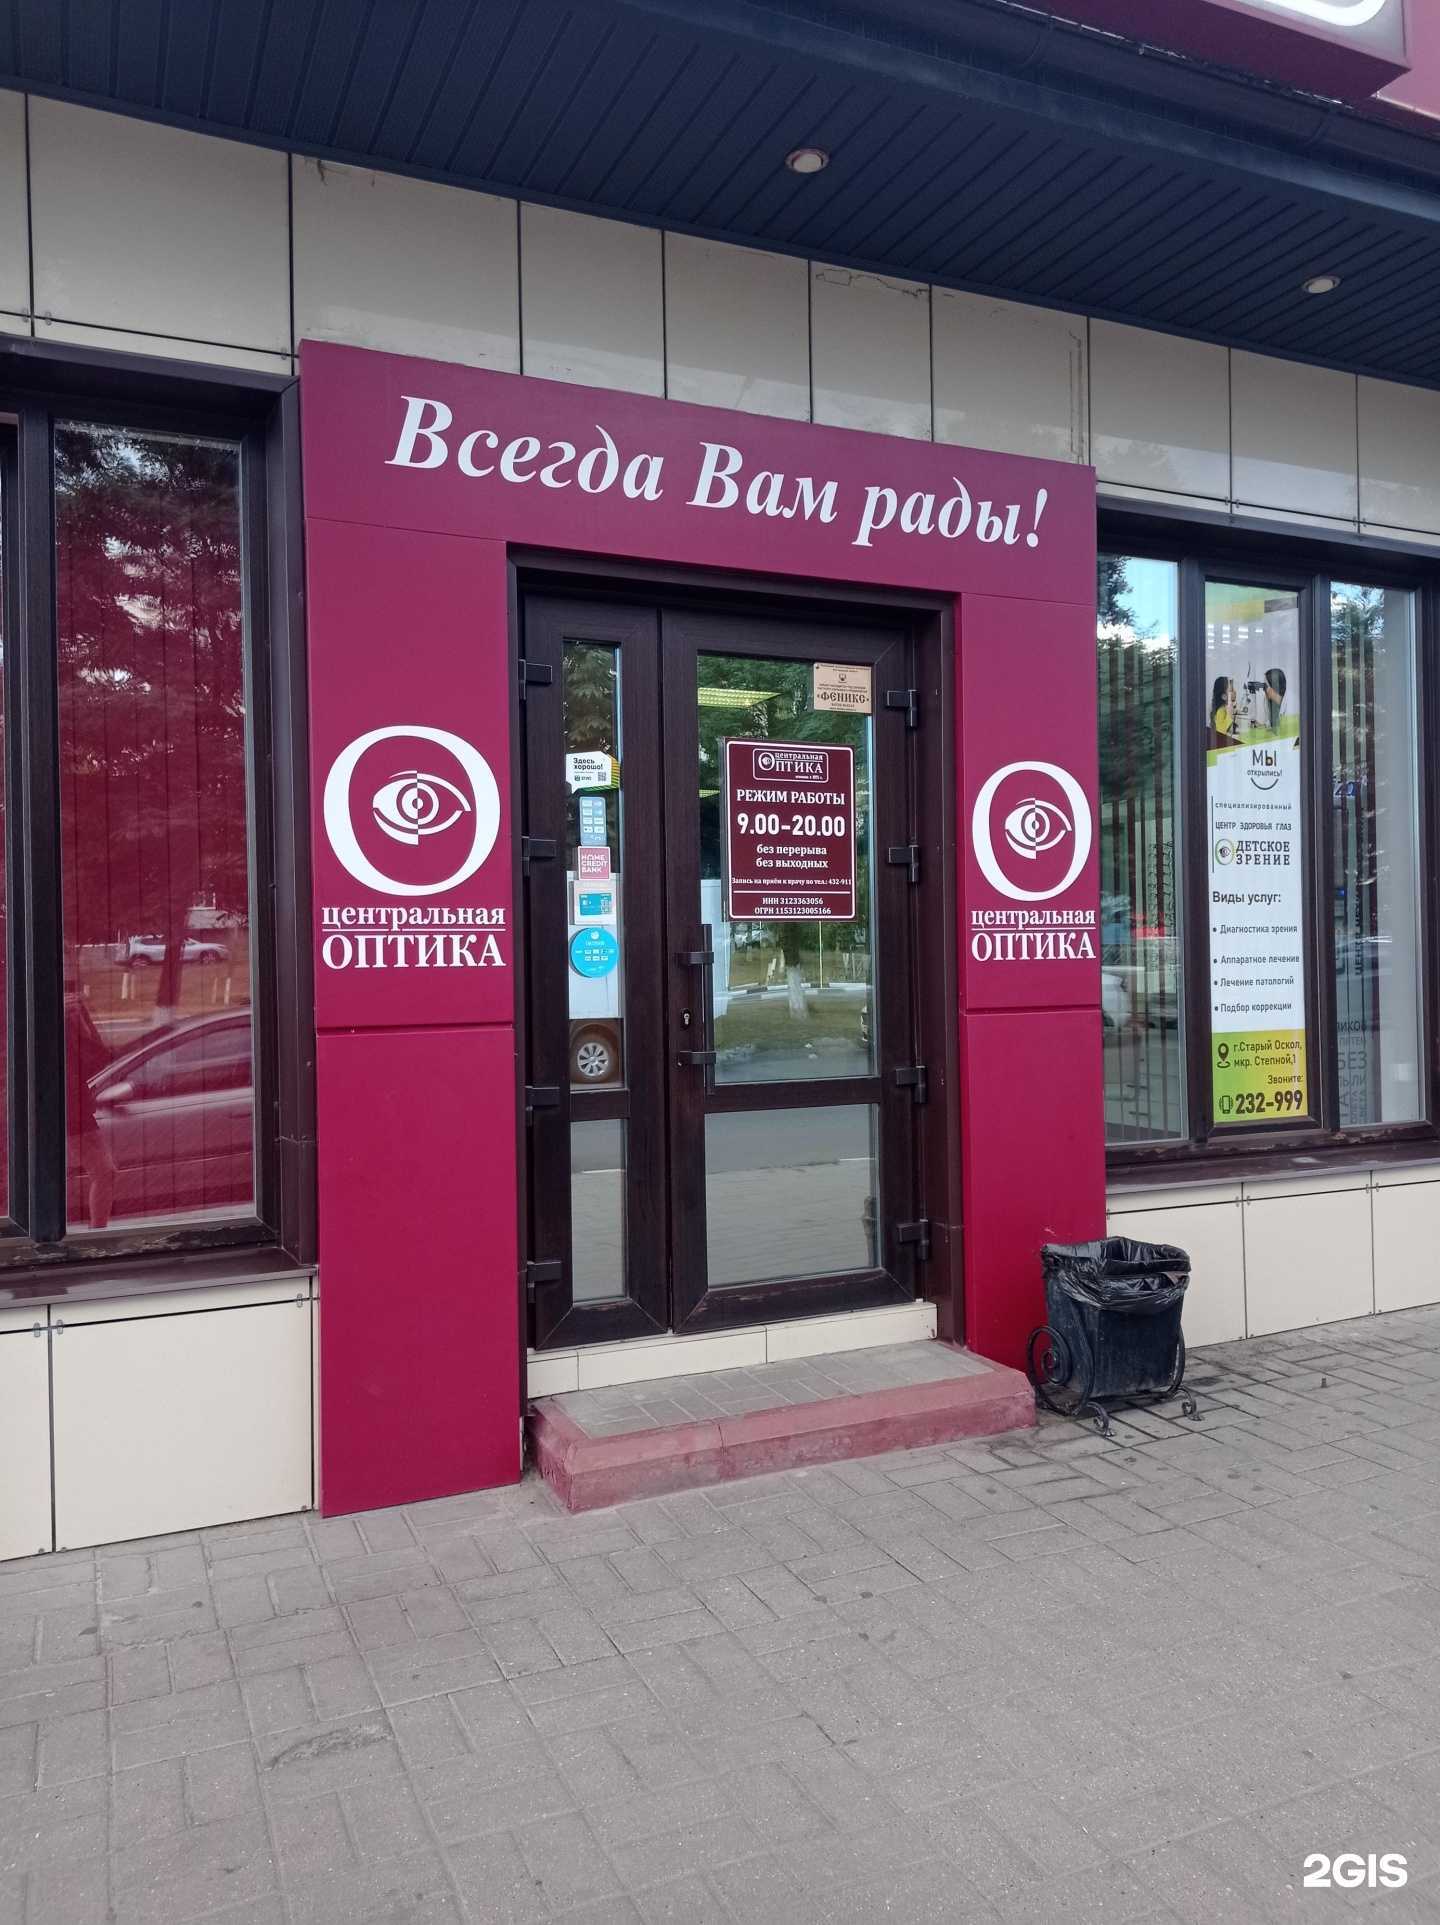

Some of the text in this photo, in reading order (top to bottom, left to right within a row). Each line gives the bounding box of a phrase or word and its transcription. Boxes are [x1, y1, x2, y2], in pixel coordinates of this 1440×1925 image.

[384, 394, 1050, 548] Всегда Вам рады!
[775, 753, 823, 761] центральная
[736, 789, 845, 805] РЕЖИМ РАБОТЫ
[1215, 802, 1292, 810] специализированный
[737, 813, 845, 837] 9.00-20.00
[1215, 821, 1292, 831] ЦЕНТР ЗДОРОВЬЯ ГЛАЗ
[757, 844, 827, 856] без перерыва
[1236, 840, 1290, 853] ДЕТСКОЕ
[756, 858, 828, 869] без выходных
[1236, 854, 1290, 866] ЗРЕНИЕ
[1212, 891, 1281, 905] Виды услуг:
[322, 907, 506, 931] центральная
[971, 910, 1096, 930] центральная
[1220, 924, 1297, 935] Диагностика зрения
[322, 934, 506, 969] ОПТИКА
[971, 932, 1096, 961] ОПТИКА
[1221, 955, 1266, 965] Аппаратное
[1220, 976, 1294, 987] Лечение патологий
[1220, 1003, 1292, 1013] Подбор коррекции
[1274, 1040, 1303, 1050] Оскол,
[1234, 1058, 1253, 1069] мкр.
[1267, 1075, 1304, 1085] Звоните:
[1235, 1090, 1303, 1114] 232-999
